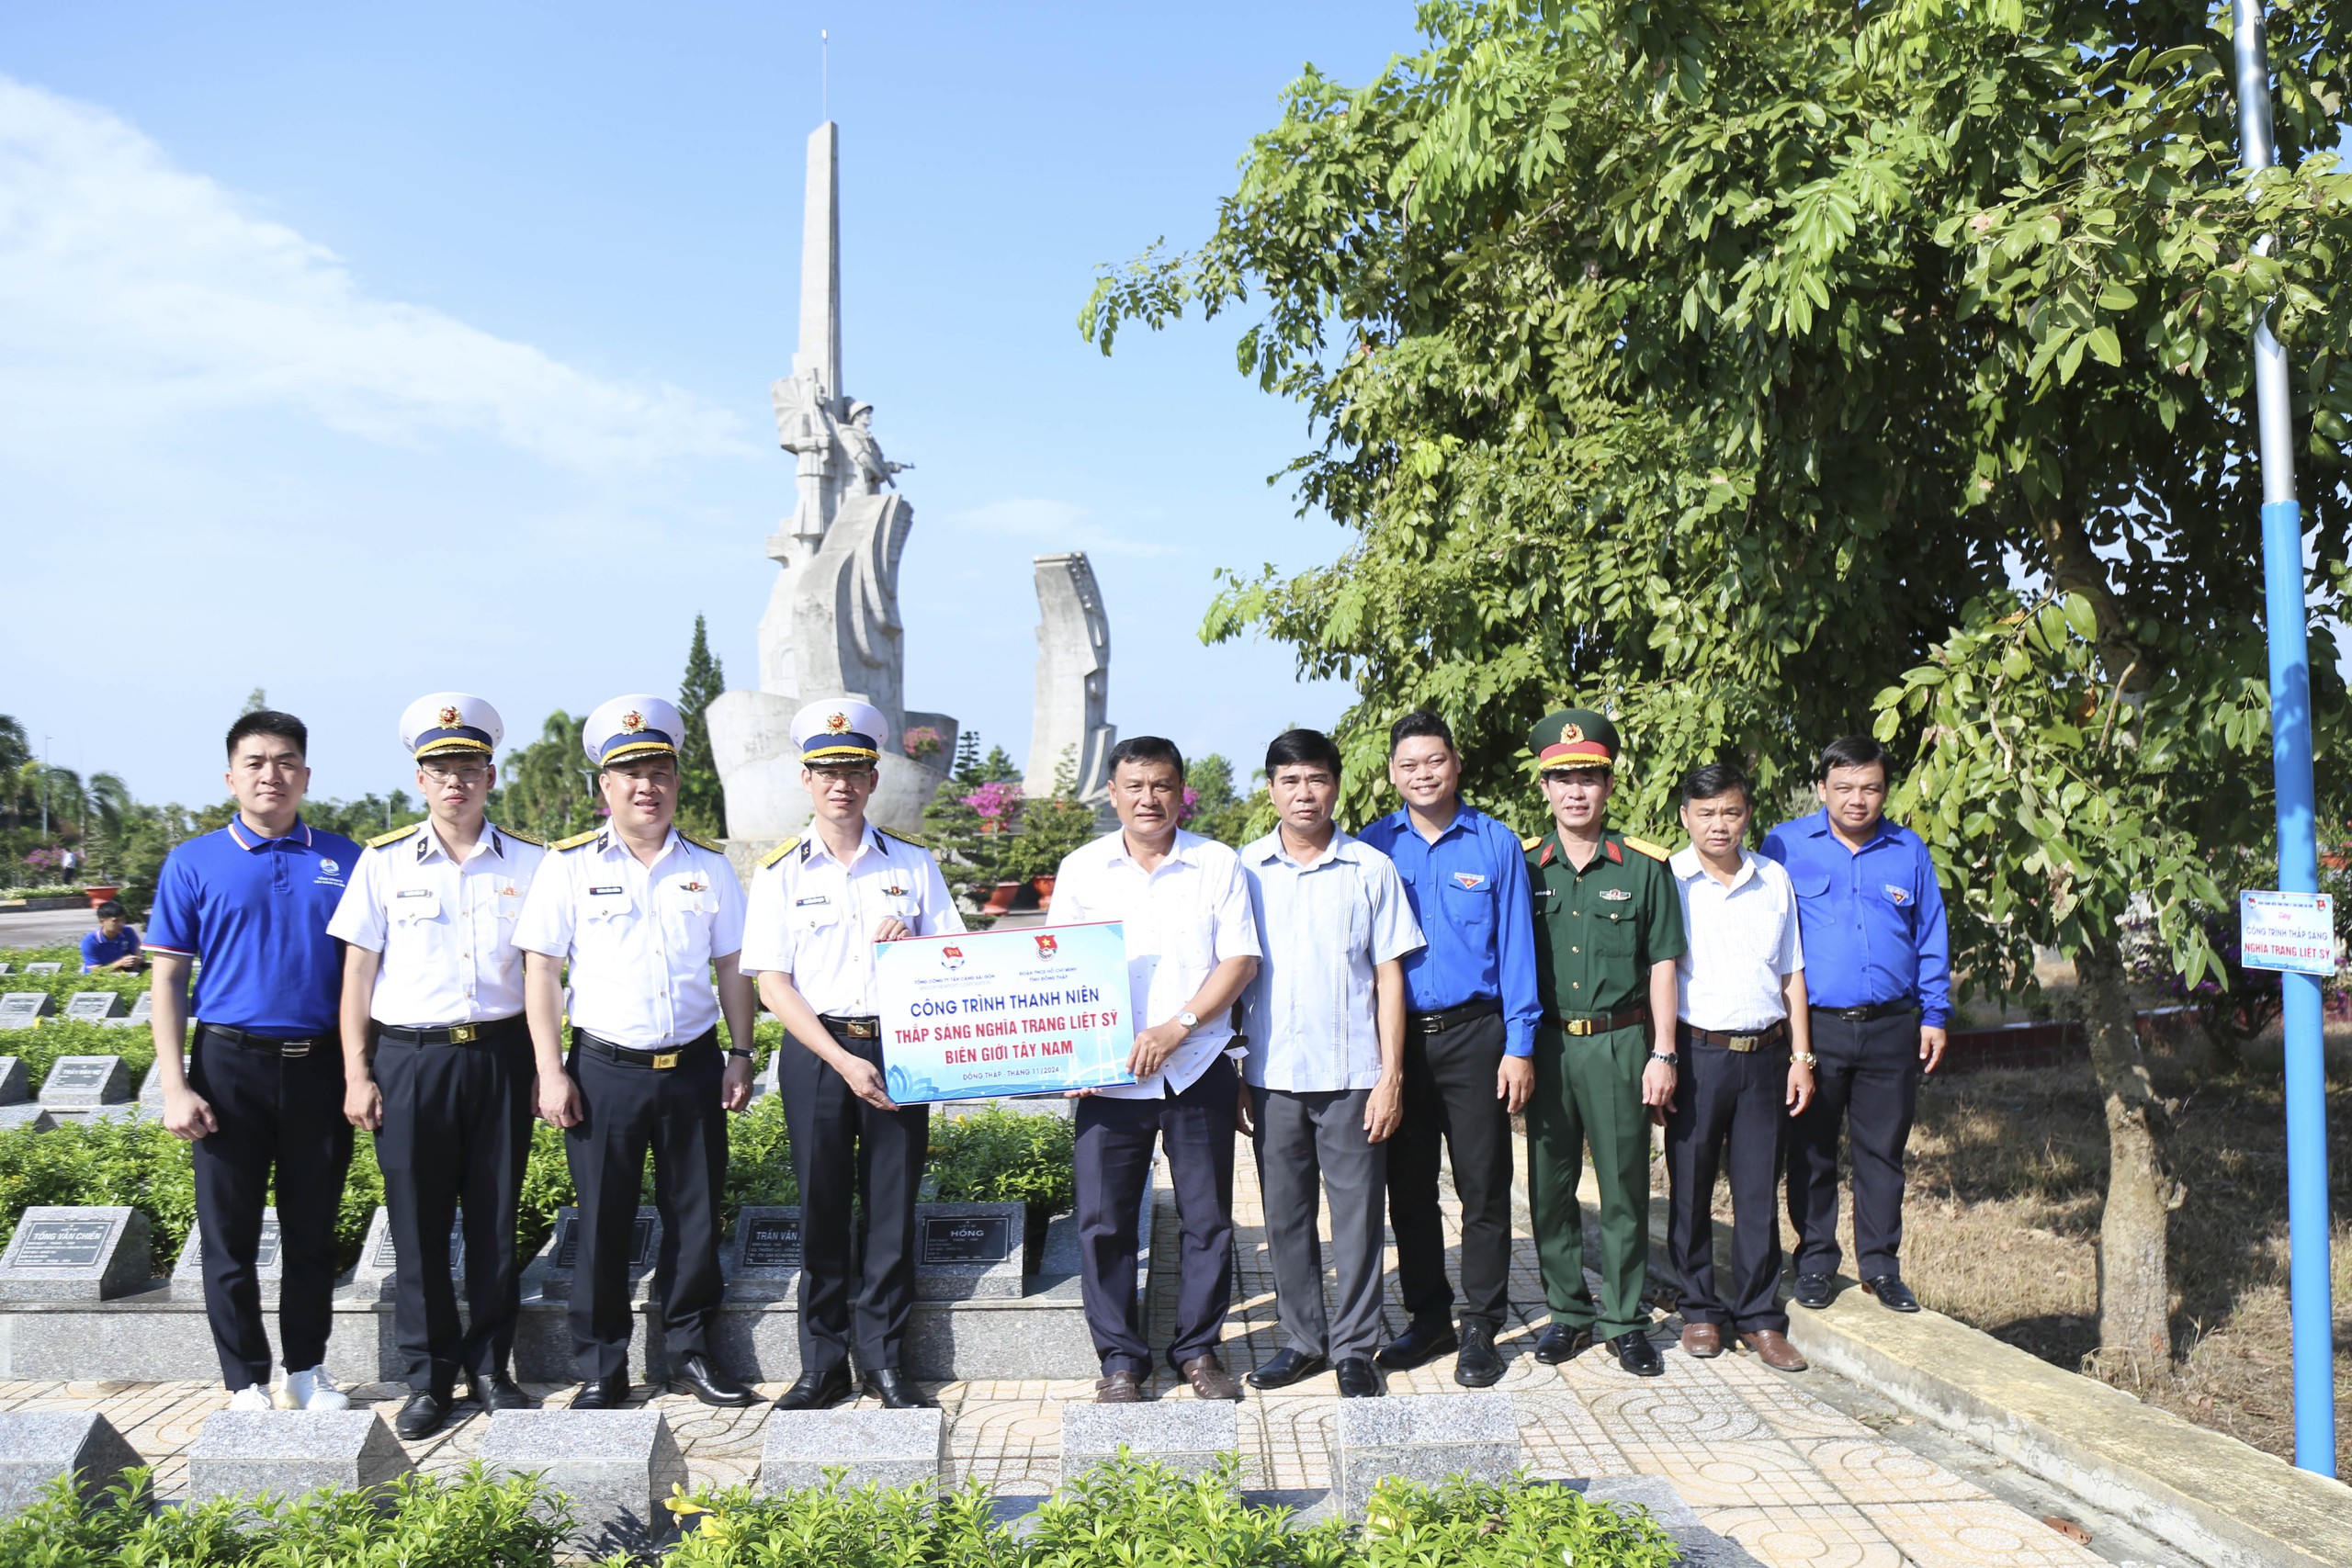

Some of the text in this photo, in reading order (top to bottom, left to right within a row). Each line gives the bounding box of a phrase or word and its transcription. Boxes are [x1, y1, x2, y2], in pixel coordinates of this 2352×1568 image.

[2246, 924, 2266, 935] CÔNG
[2268, 926, 2287, 937] TRÌNH
[2245, 942, 2268, 953] NGHĨA
[2271, 944, 2297, 956] TRANG
[910, 985, 1099, 1017] CÔNG TRÌNH THANH NIÊN
[895, 1010, 1117, 1043] THẮP SÁNG NGHĨA TRANG LIỆT SỸ
[944, 1040, 1073, 1065] BIÊN GIỚI TÂY NAM
[1033, 1066, 1059, 1076] 11/2024
[57, 1231, 75, 1240] VĂN
[781, 1230, 797, 1240] VĂN
